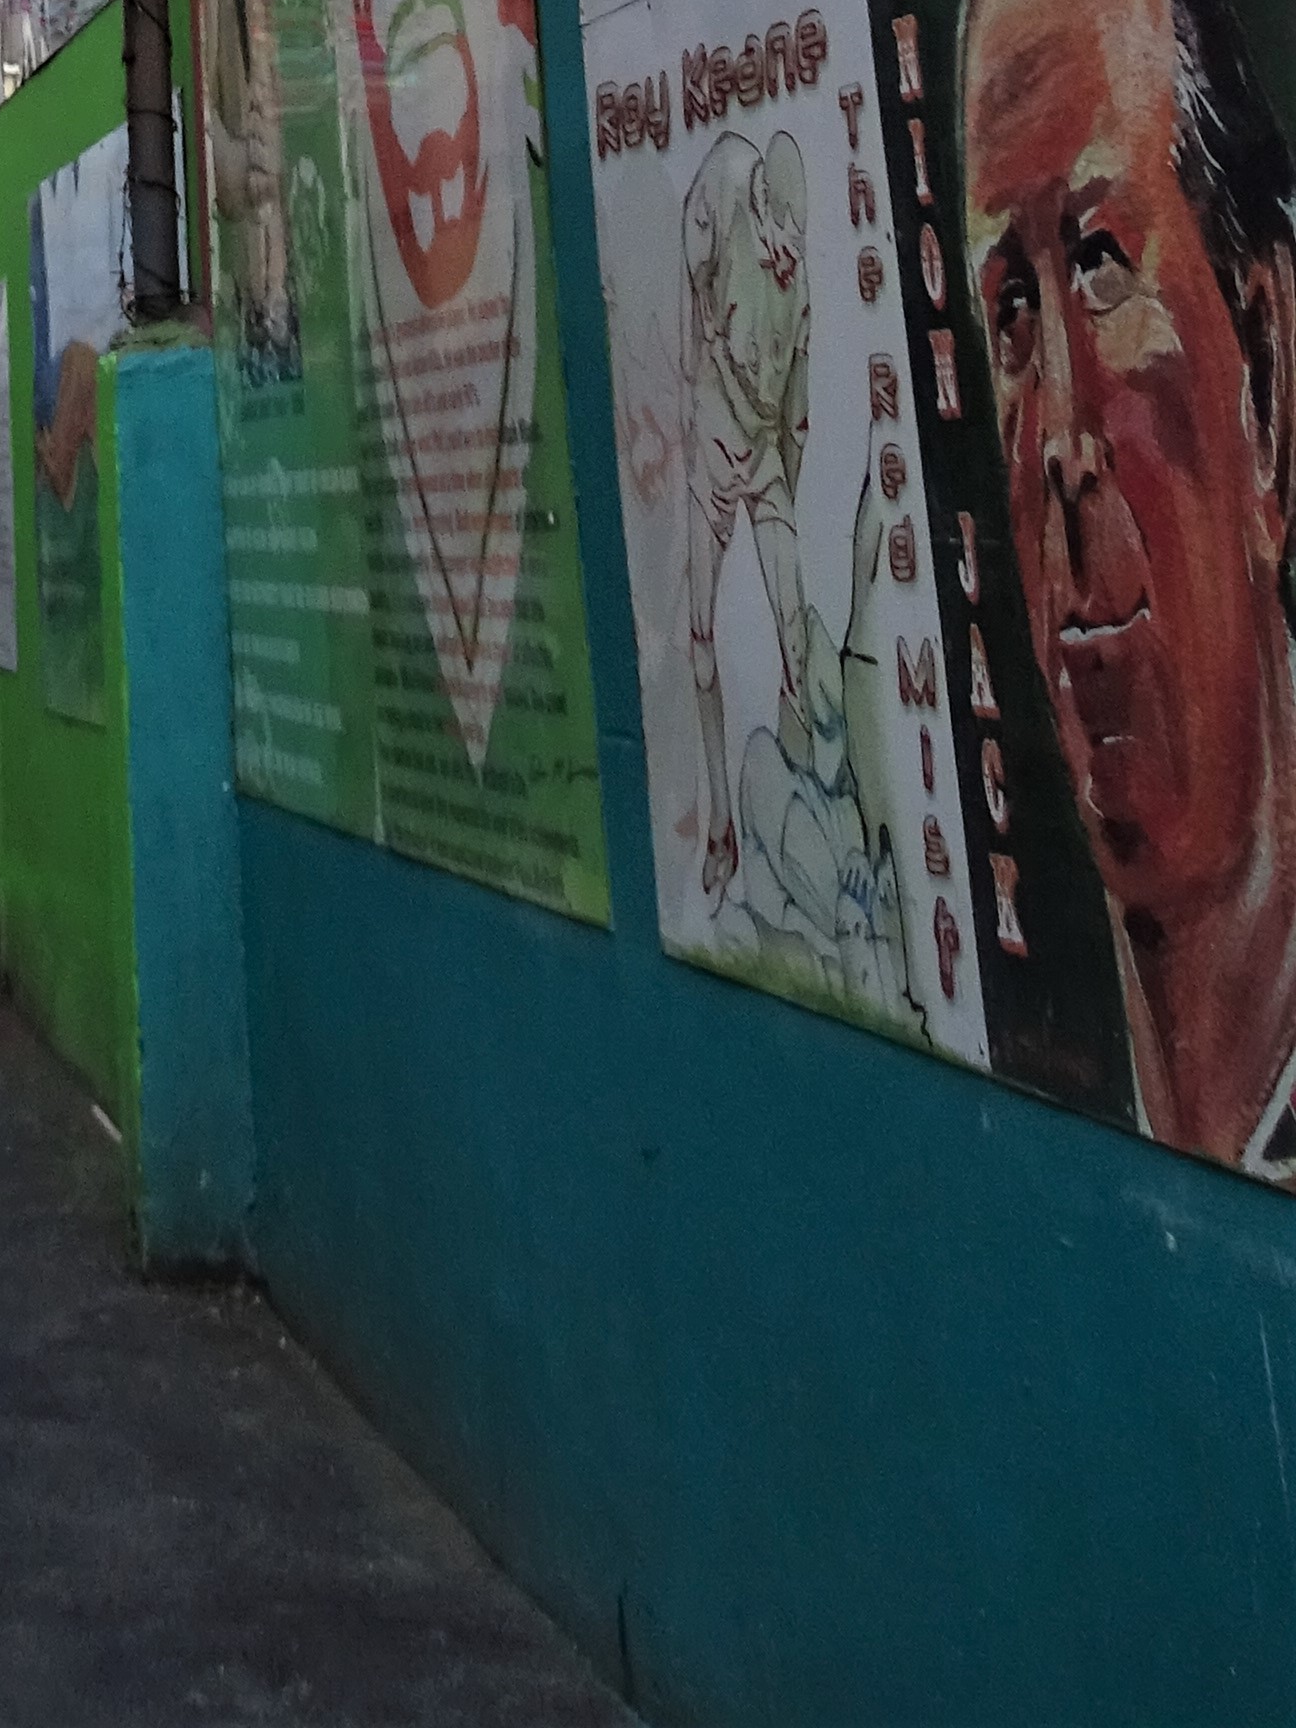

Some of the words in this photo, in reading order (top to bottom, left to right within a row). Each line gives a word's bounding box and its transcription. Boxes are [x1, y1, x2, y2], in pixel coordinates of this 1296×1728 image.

[595, 68, 671, 162] Roy
[680, 7, 829, 133] Keane
[837, 82, 889, 307] The
[896, 634, 961, 1001] Mist
[955, 510, 1029, 960] JACK
